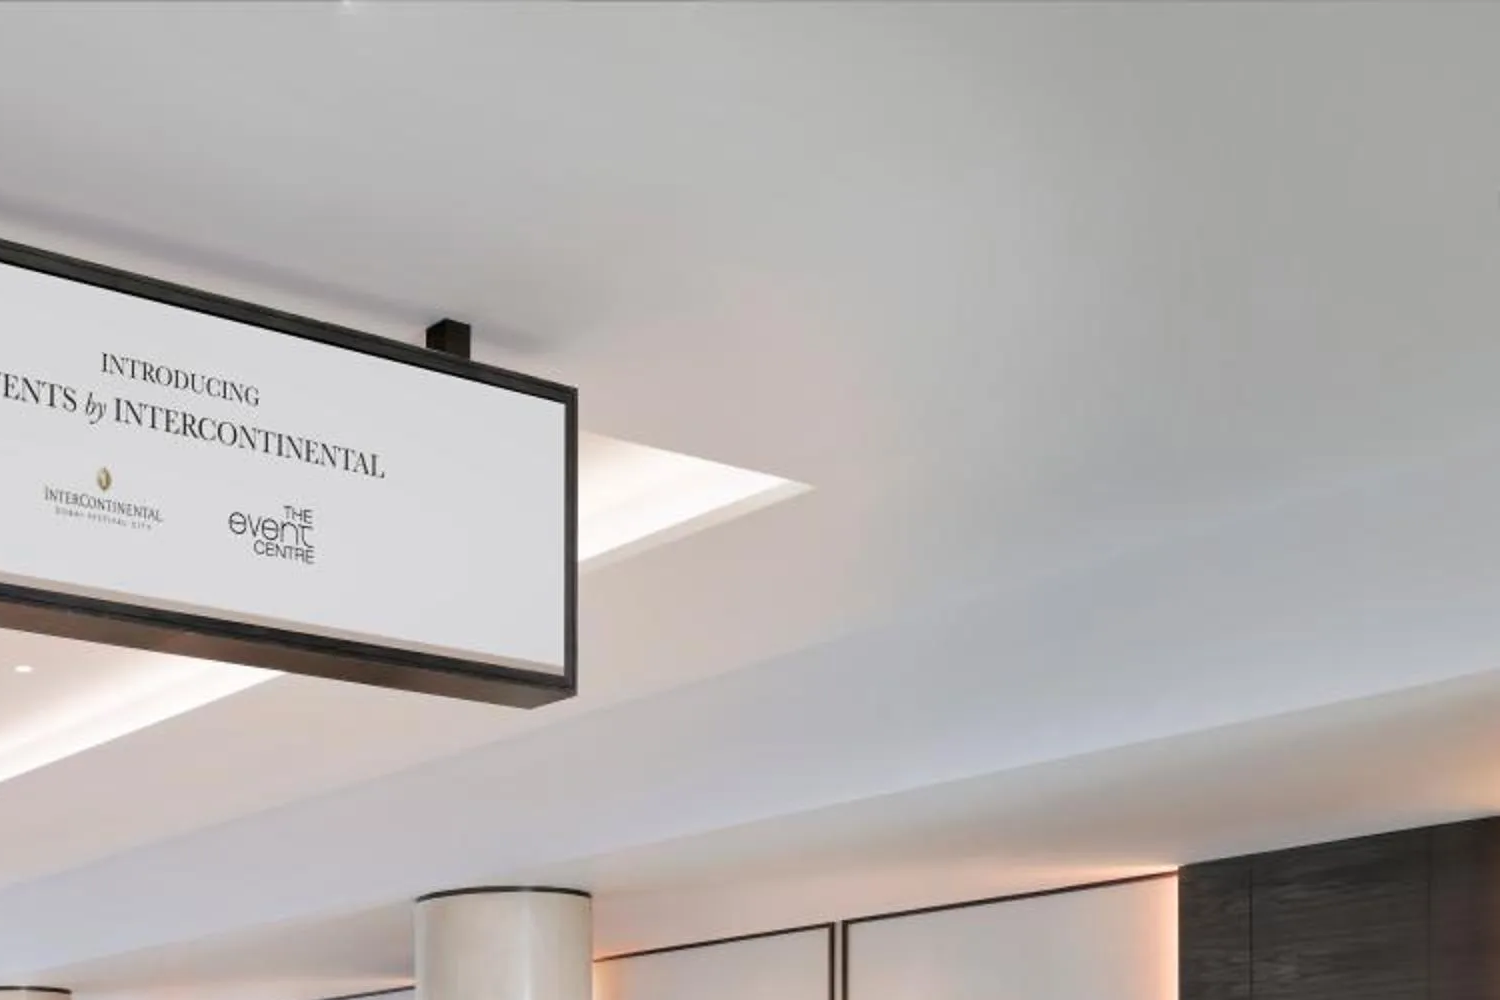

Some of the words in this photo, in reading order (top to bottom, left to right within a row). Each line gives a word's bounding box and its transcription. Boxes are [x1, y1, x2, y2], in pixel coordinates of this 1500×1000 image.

[101, 352, 260, 407] INTRODUCING
[85, 391, 108, 426] by
[115, 397, 386, 479] INTERCONTINENTAL
[228, 511, 315, 549] event
[283, 505, 314, 525] THE
[253, 539, 316, 565] CENTRE
